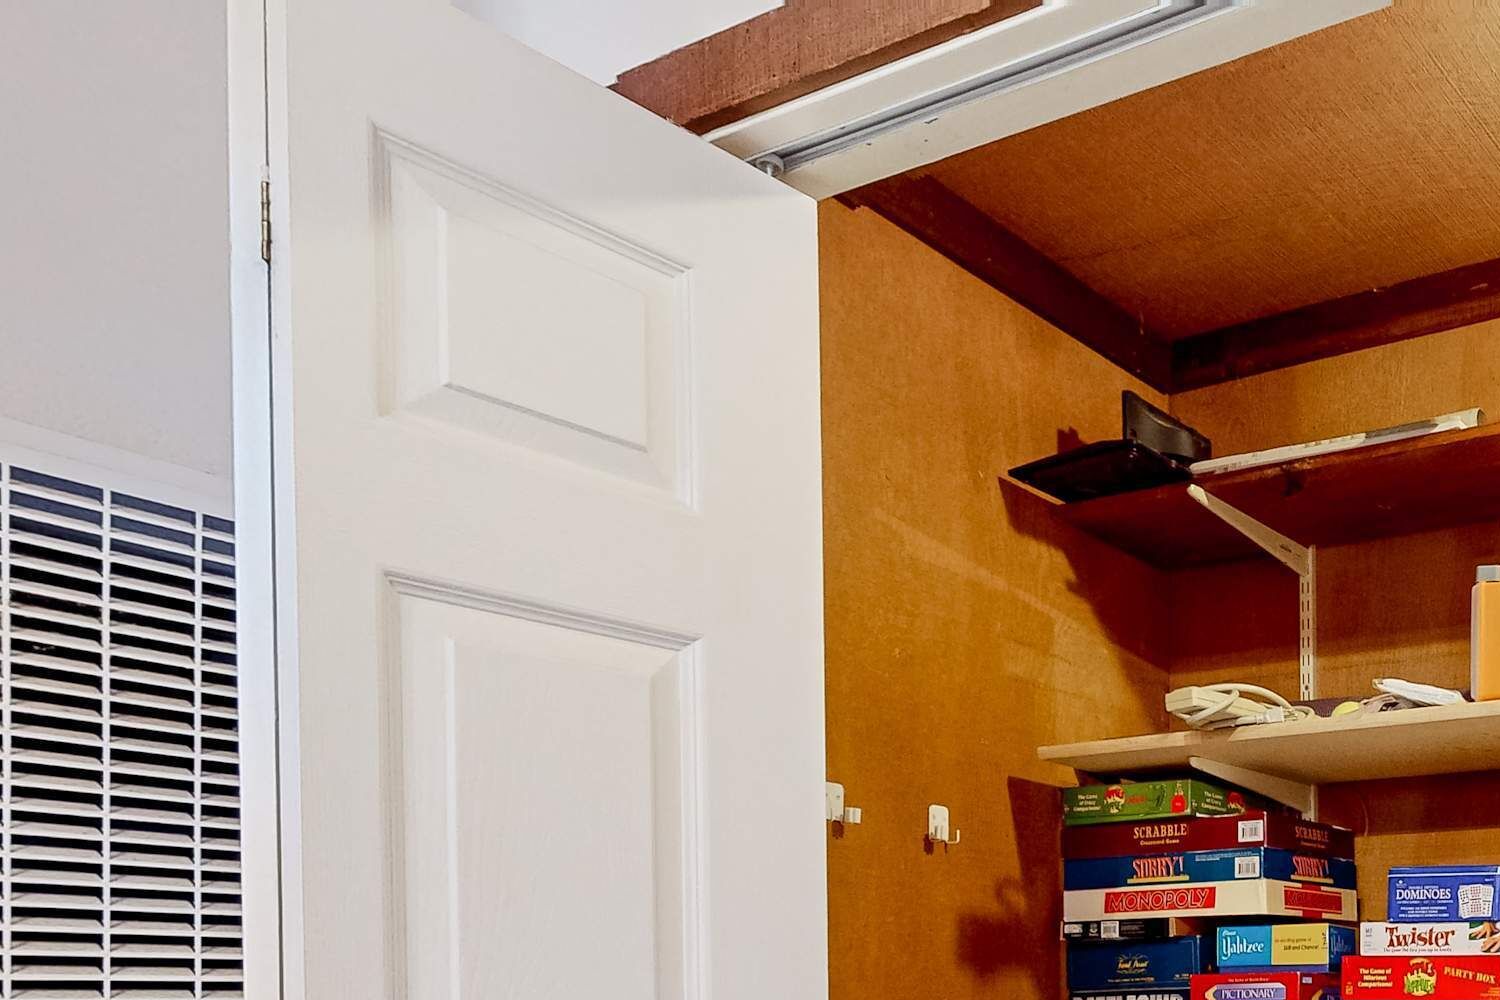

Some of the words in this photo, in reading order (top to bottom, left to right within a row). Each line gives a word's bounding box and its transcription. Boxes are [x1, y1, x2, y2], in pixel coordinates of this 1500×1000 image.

[1133, 823, 1187, 840] SCRABBLE
[1295, 826, 1329, 842] SCRABBLE
[1132, 855, 1185, 878] SORRY!
[1293, 856, 1330, 877] SORRY!
[1108, 888, 1210, 912] MONOPOLY
[1396, 888, 1452, 900] DOMINOES
[1385, 926, 1456, 948] Twister
[1221, 935, 1265, 961] Yahtzee
[1444, 966, 1473, 981] PARTY
[1476, 974, 1497, 984] BOX
[1221, 988, 1276, 1000] PICTIONARY
